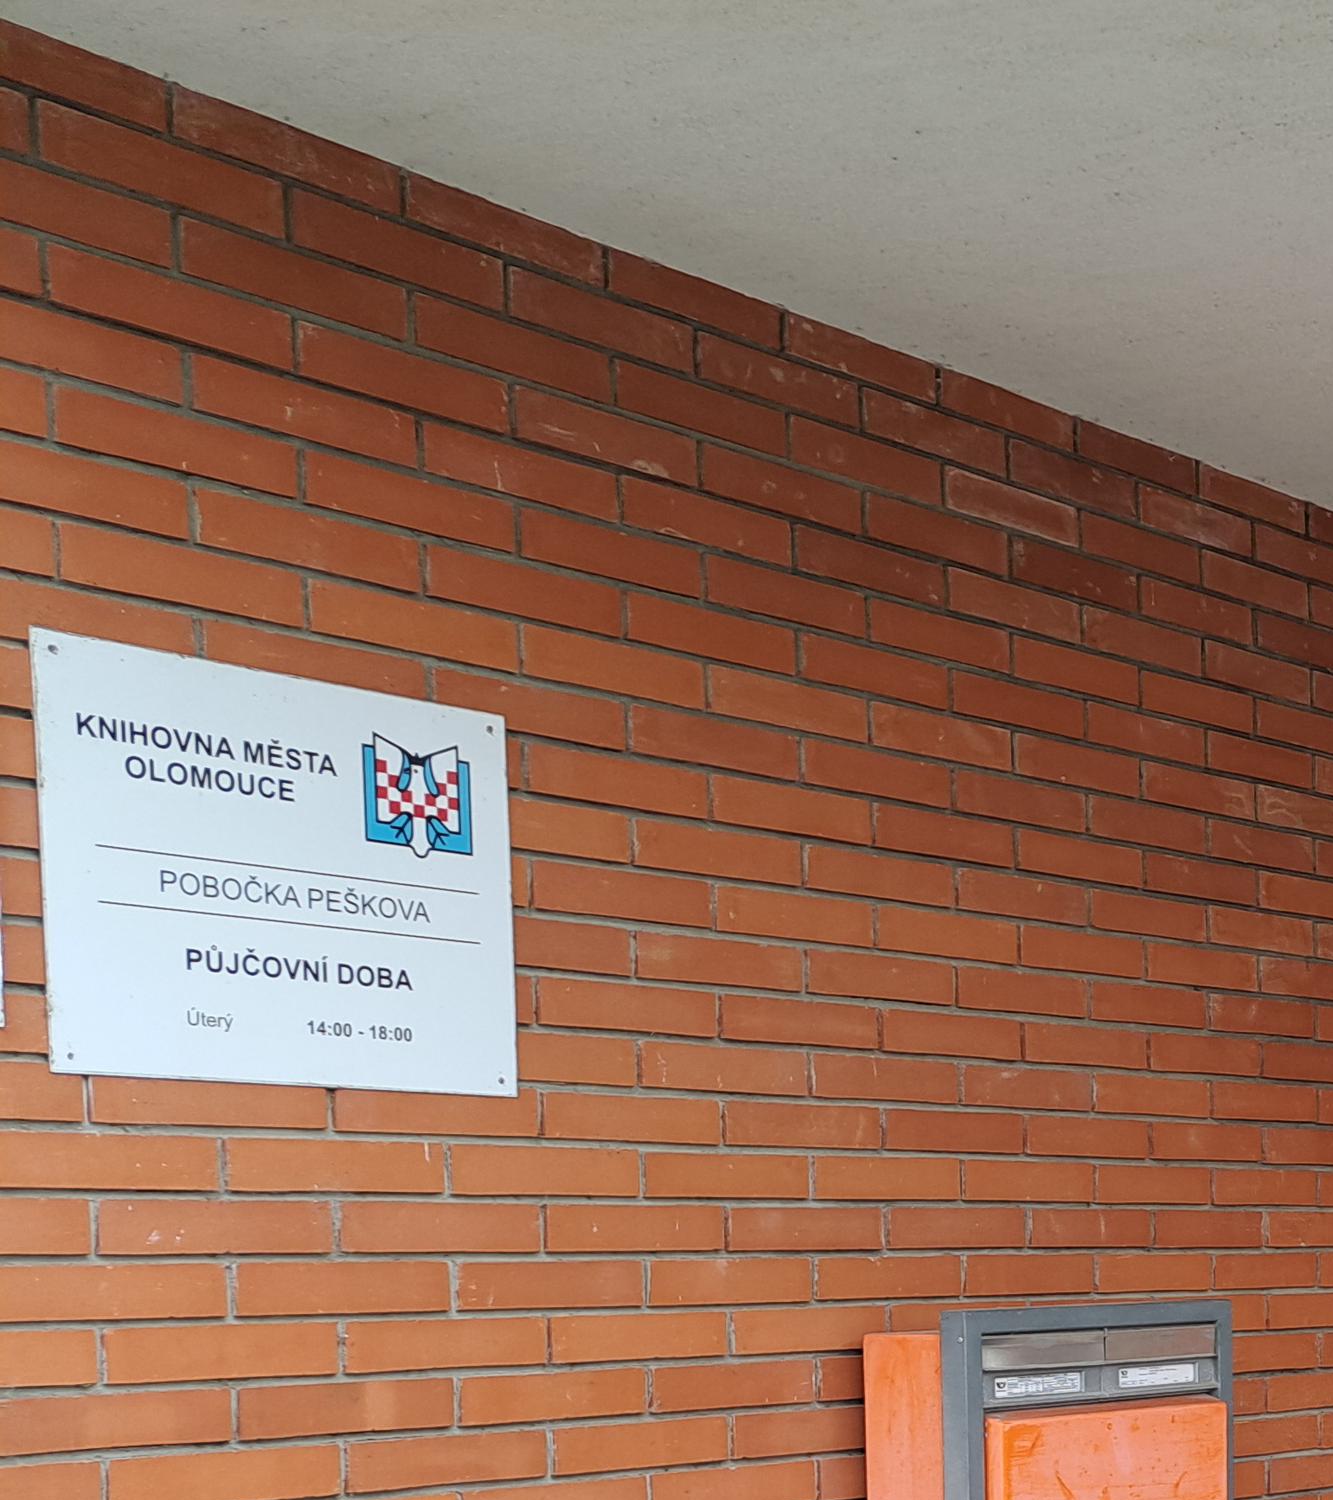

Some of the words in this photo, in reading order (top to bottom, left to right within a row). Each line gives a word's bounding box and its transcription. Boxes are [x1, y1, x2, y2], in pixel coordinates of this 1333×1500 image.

[75, 711, 236, 760] KNIHOVNA
[243, 738, 339, 777] MĚSTA
[124, 755, 296, 802] OLOMOUCE
[159, 869, 302, 909] POBOČKA
[307, 887, 432, 924] PEŠKOVA
[185, 944, 329, 983] PŮJČOVNÍ
[337, 963, 414, 991] DOBA
[186, 1006, 234, 1032] Úterý
[306, 1020, 353, 1038] 14:00
[368, 1025, 413, 1042] 18:00
